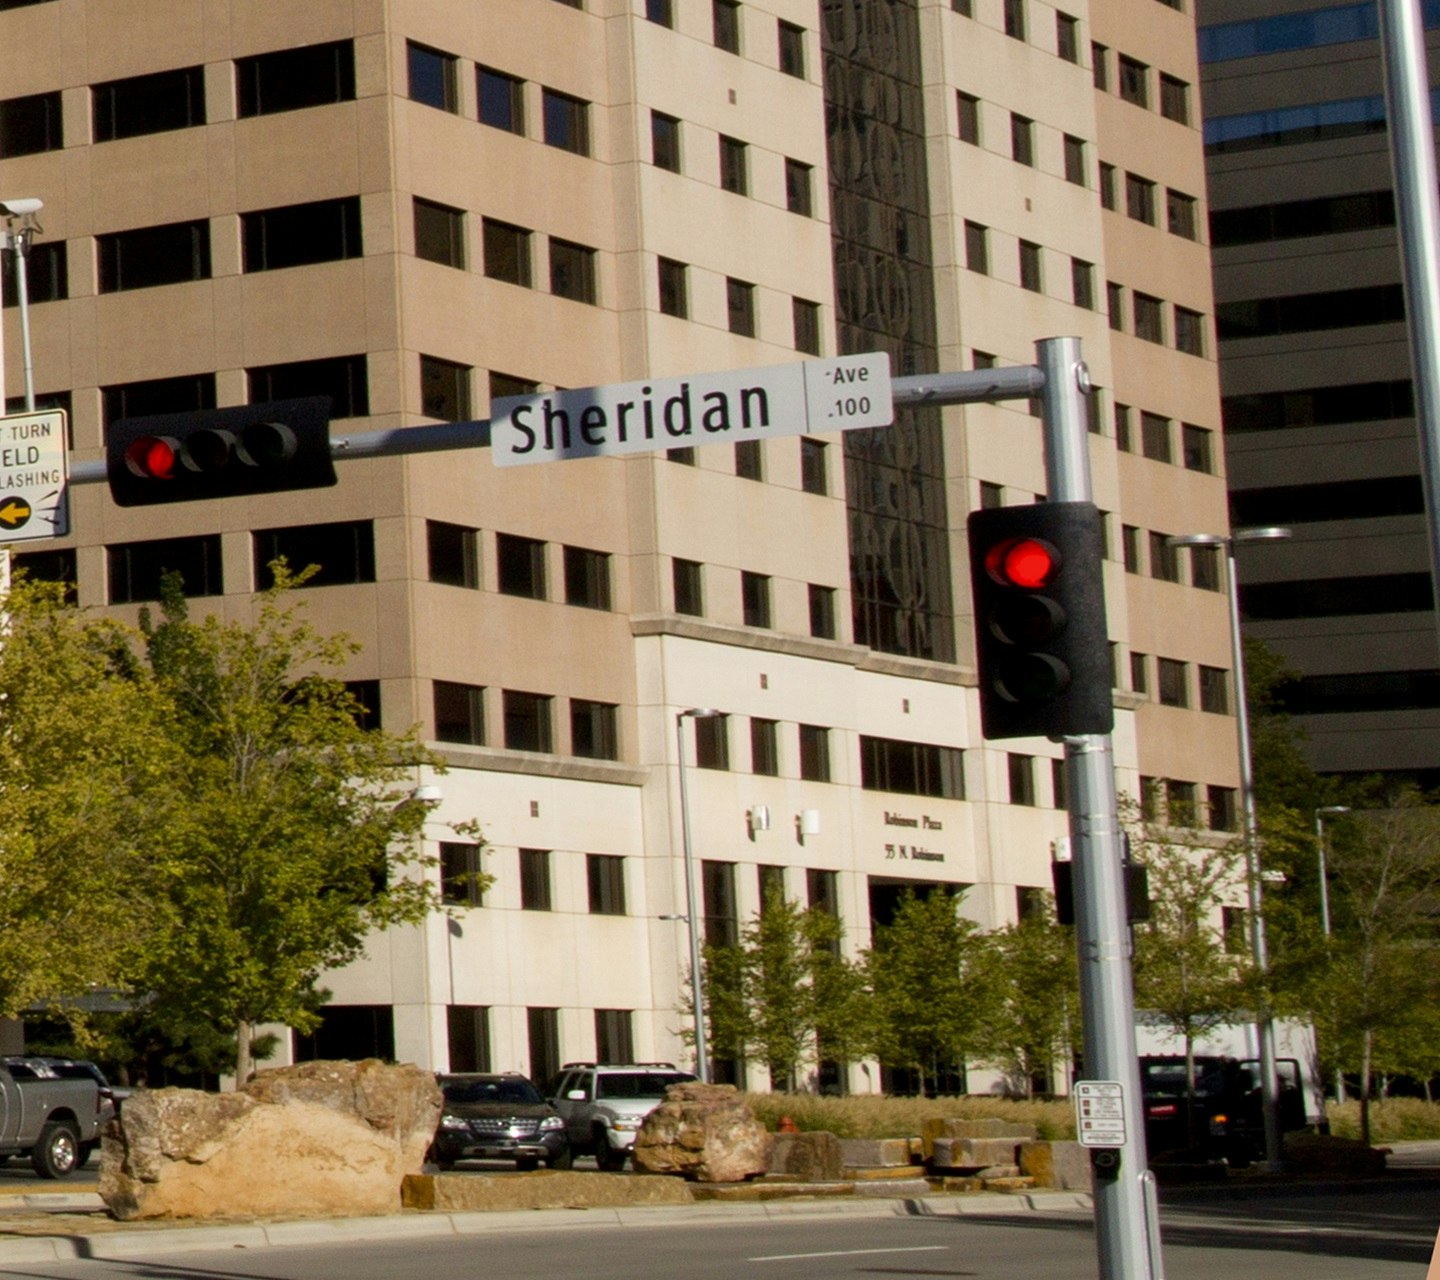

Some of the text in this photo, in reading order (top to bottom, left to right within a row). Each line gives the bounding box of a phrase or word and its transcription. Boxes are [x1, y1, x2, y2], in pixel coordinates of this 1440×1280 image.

[833, 364, 870, 385] Ave
[834, 396, 872, 417] 100
[509, 382, 771, 454] Sheridan
[11, 423, 51, 441] TURN
[884, 811, 943, 831] Robinson Plaza
[910, 845, 945, 863] Robinson
